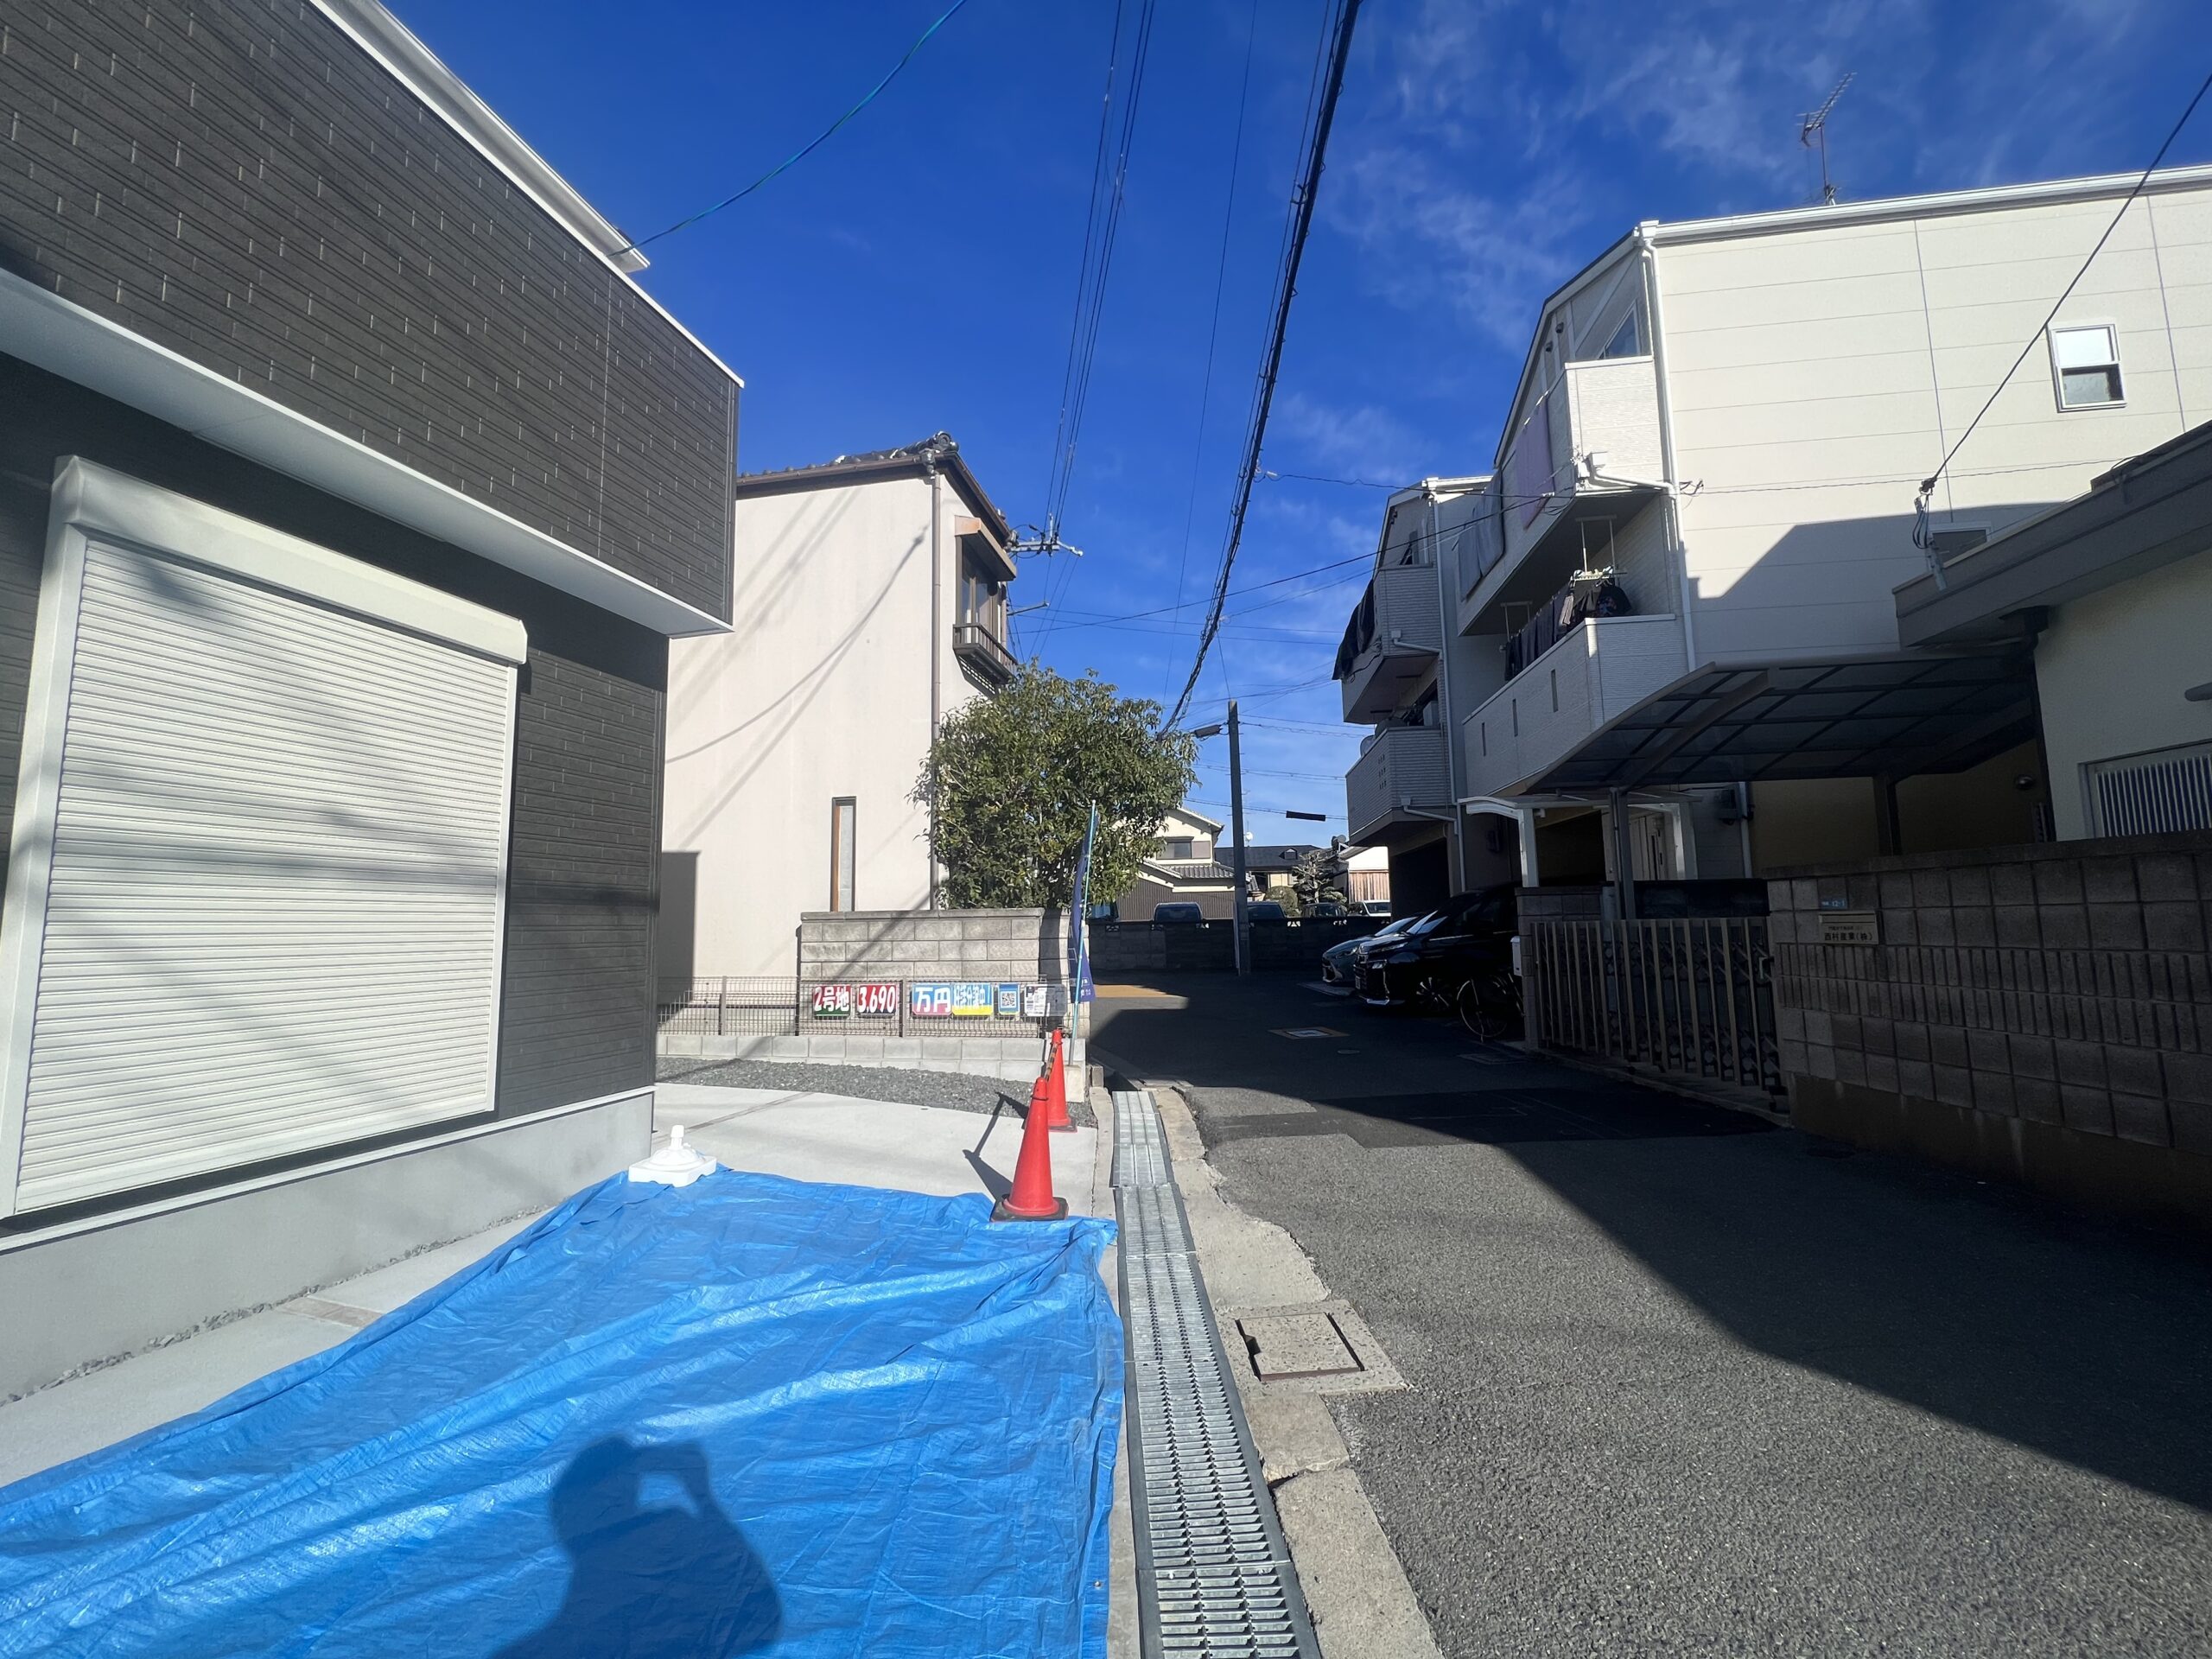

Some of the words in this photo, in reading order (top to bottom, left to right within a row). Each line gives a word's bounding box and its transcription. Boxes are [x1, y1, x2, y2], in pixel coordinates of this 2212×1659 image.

[814, 986, 849, 1011] 2号地
[857, 986, 896, 1013] 3,690
[915, 987, 951, 1013] 万円
